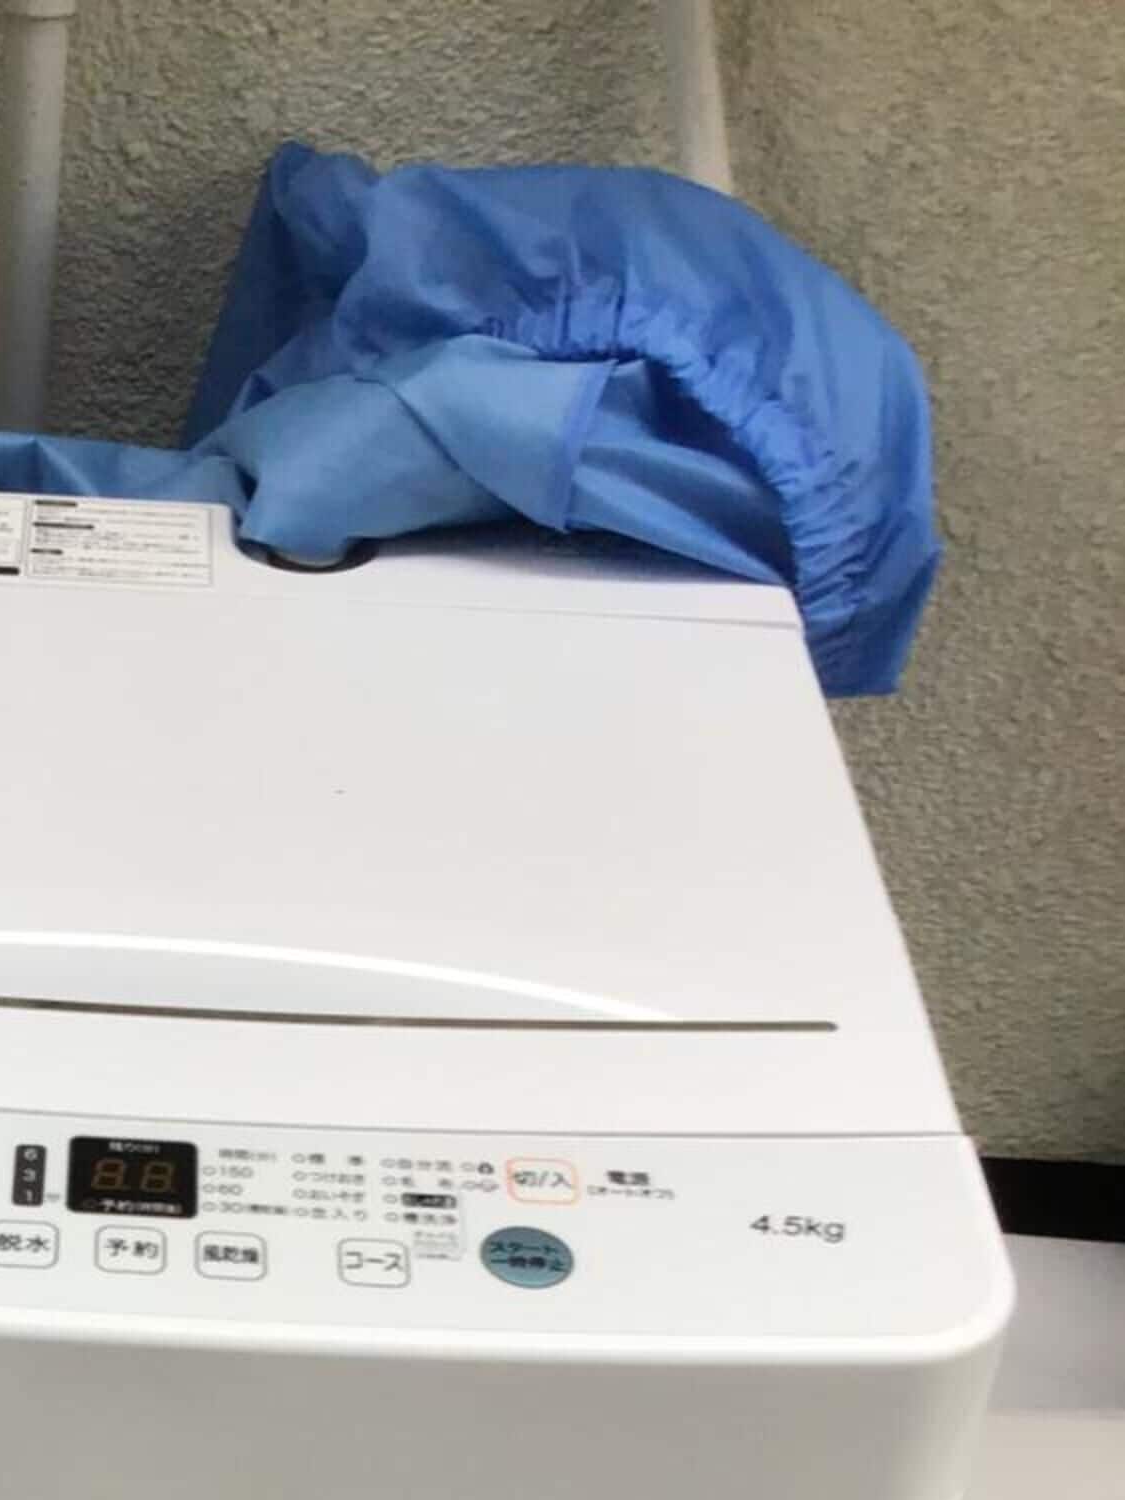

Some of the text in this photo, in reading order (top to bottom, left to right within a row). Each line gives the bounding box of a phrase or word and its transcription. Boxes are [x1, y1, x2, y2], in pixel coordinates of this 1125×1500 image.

[749, 1214, 846, 1243] 4.5kg
[343, 1251, 404, 1271] コース
